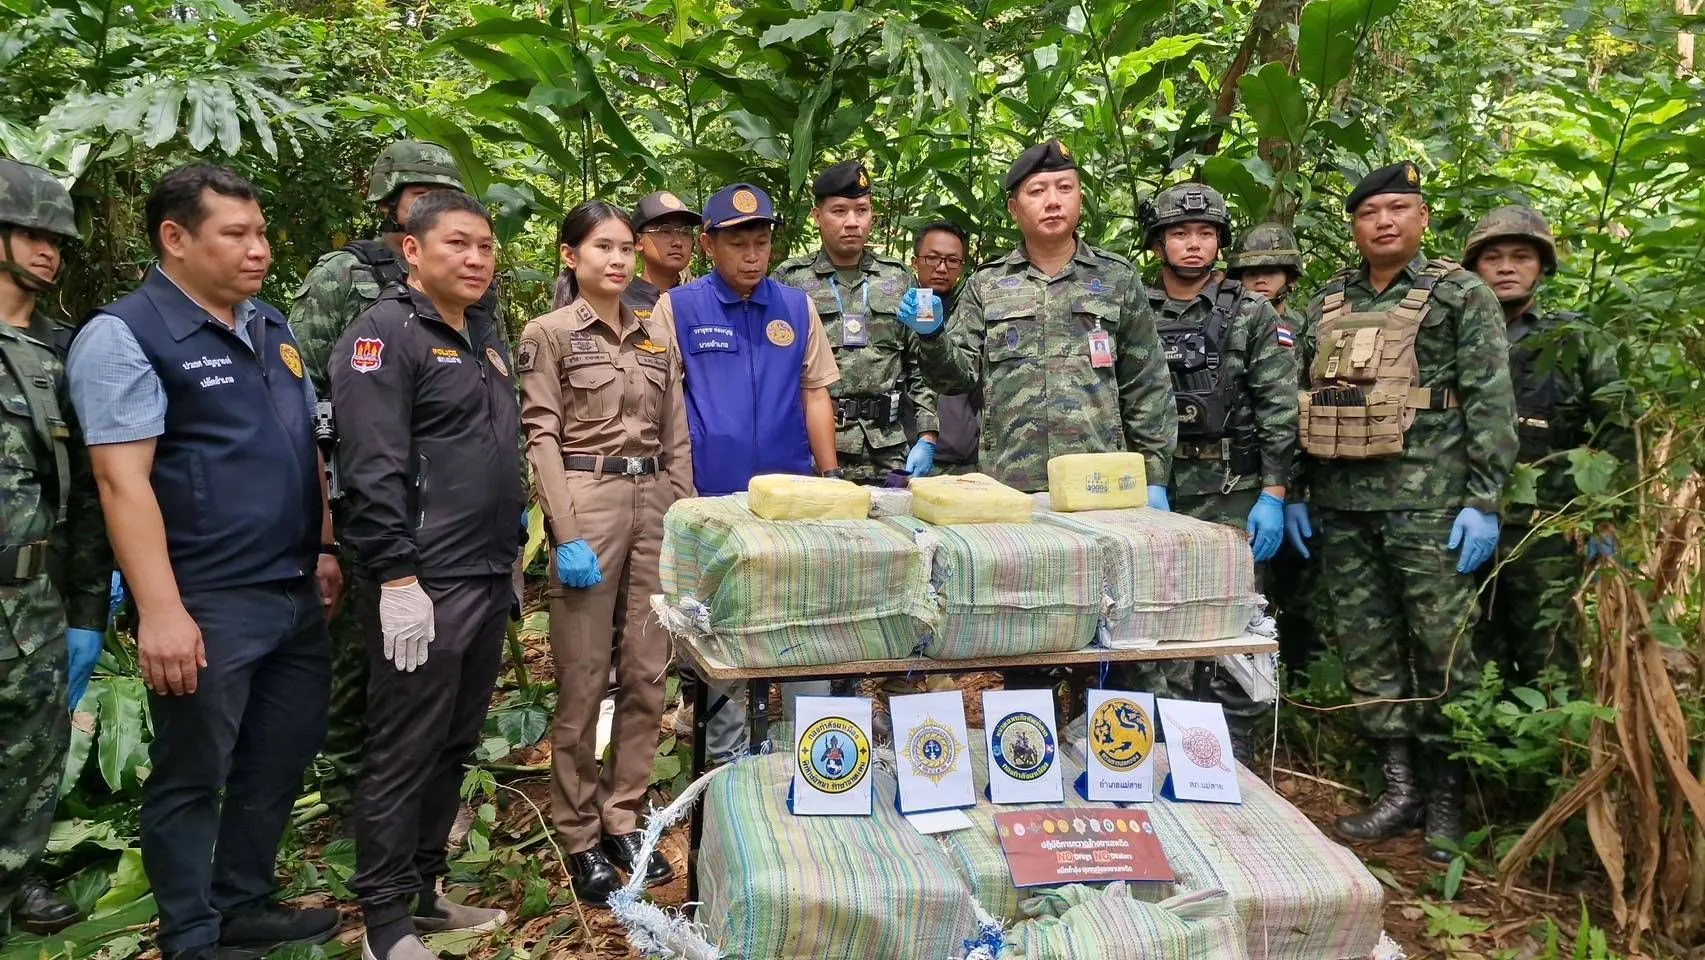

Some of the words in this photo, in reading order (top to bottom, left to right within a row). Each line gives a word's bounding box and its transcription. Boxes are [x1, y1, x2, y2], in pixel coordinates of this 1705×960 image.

[699, 340, 729, 348] นายอำเภอ
[432, 348, 457, 357] POLICE
[200, 375, 234, 388] ปลัดอำเภอ
[808, 720, 859, 739] กองกำลังผาเมือง
[1099, 779, 1142, 789] อำเภอแม่สาย
[1056, 851, 1073, 863] NO
[1093, 850, 1110, 861] NO
